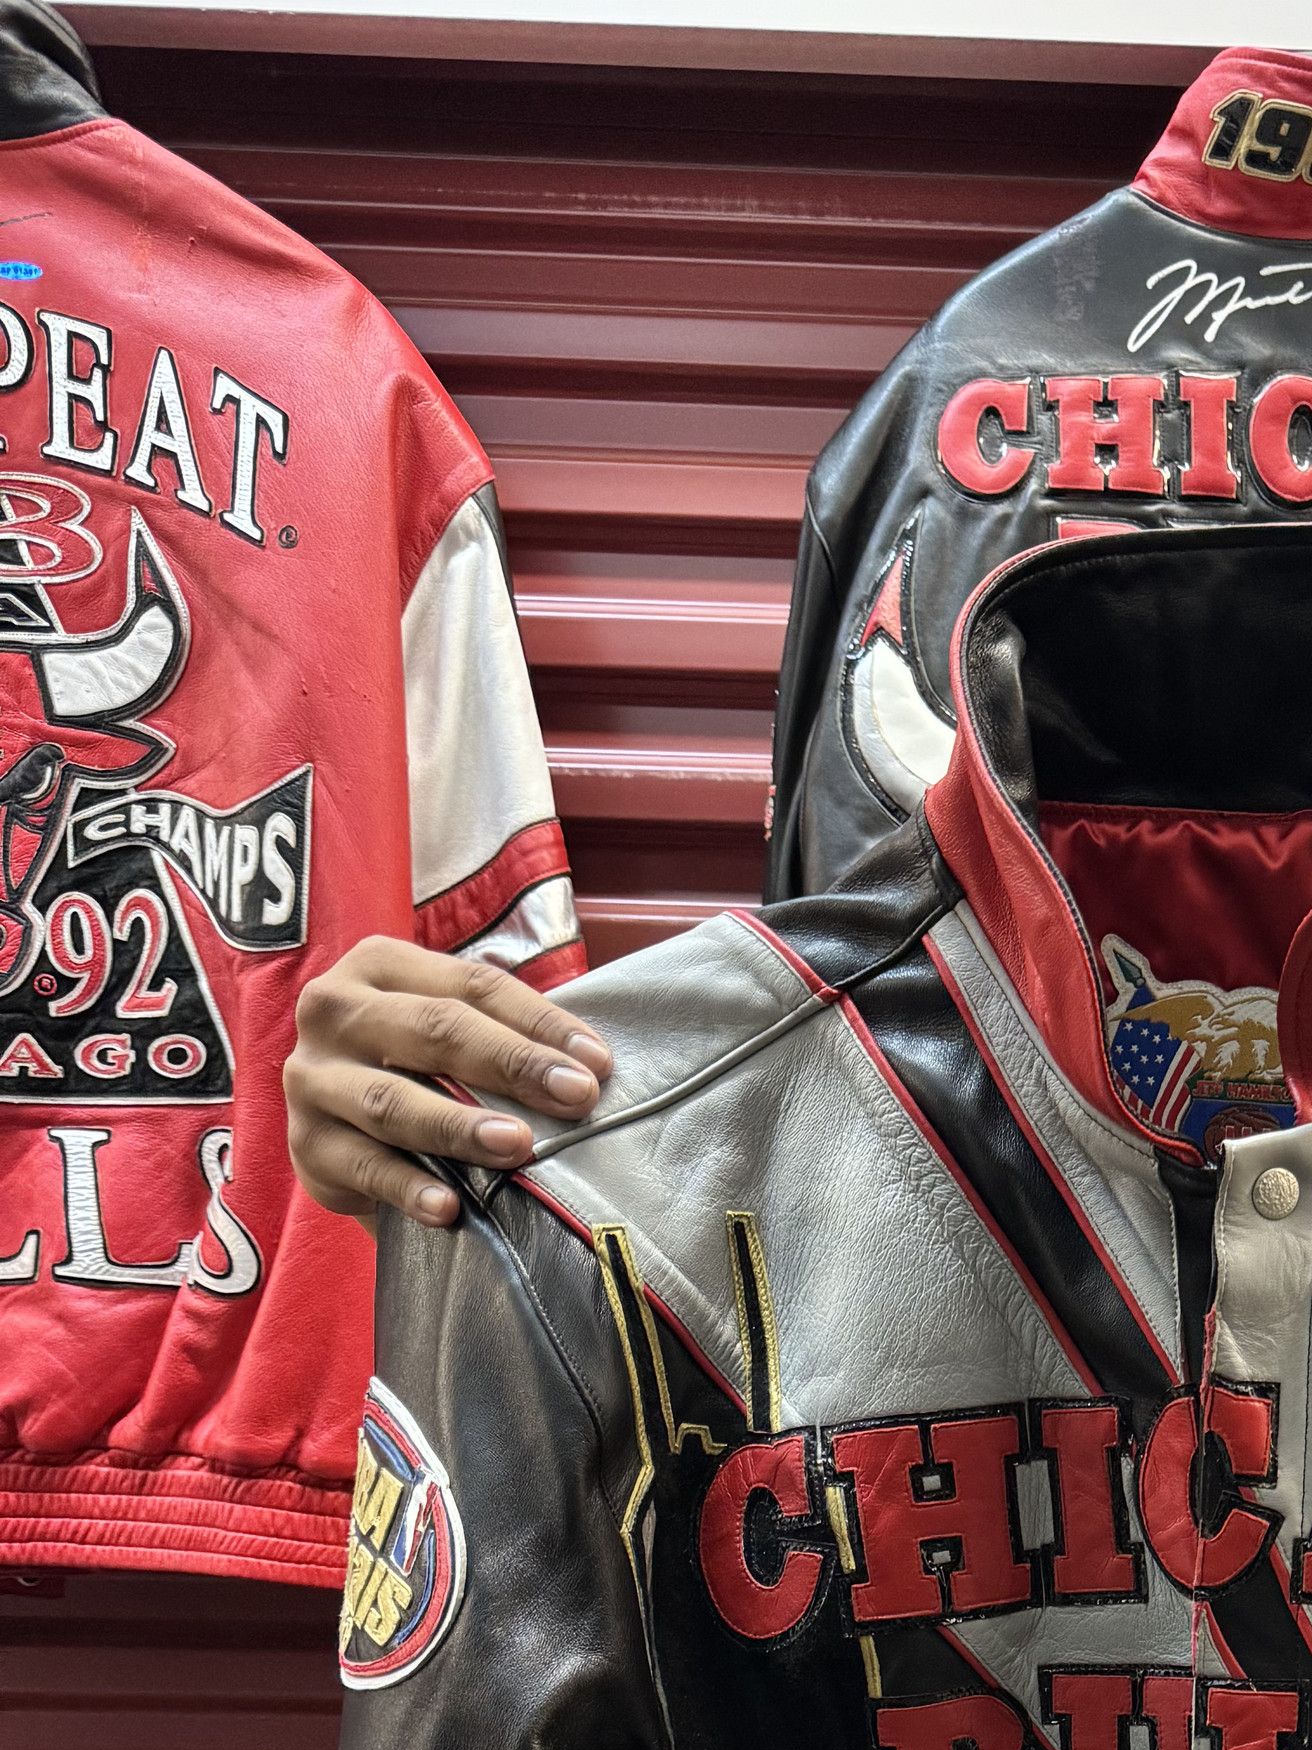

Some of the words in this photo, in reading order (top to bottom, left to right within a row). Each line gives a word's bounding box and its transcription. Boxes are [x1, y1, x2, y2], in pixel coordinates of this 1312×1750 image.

[82, 800, 298, 926] CHAMPS
[1226, 1082, 1292, 1103] HAMILTO
[0, 1127, 263, 1299] LS
